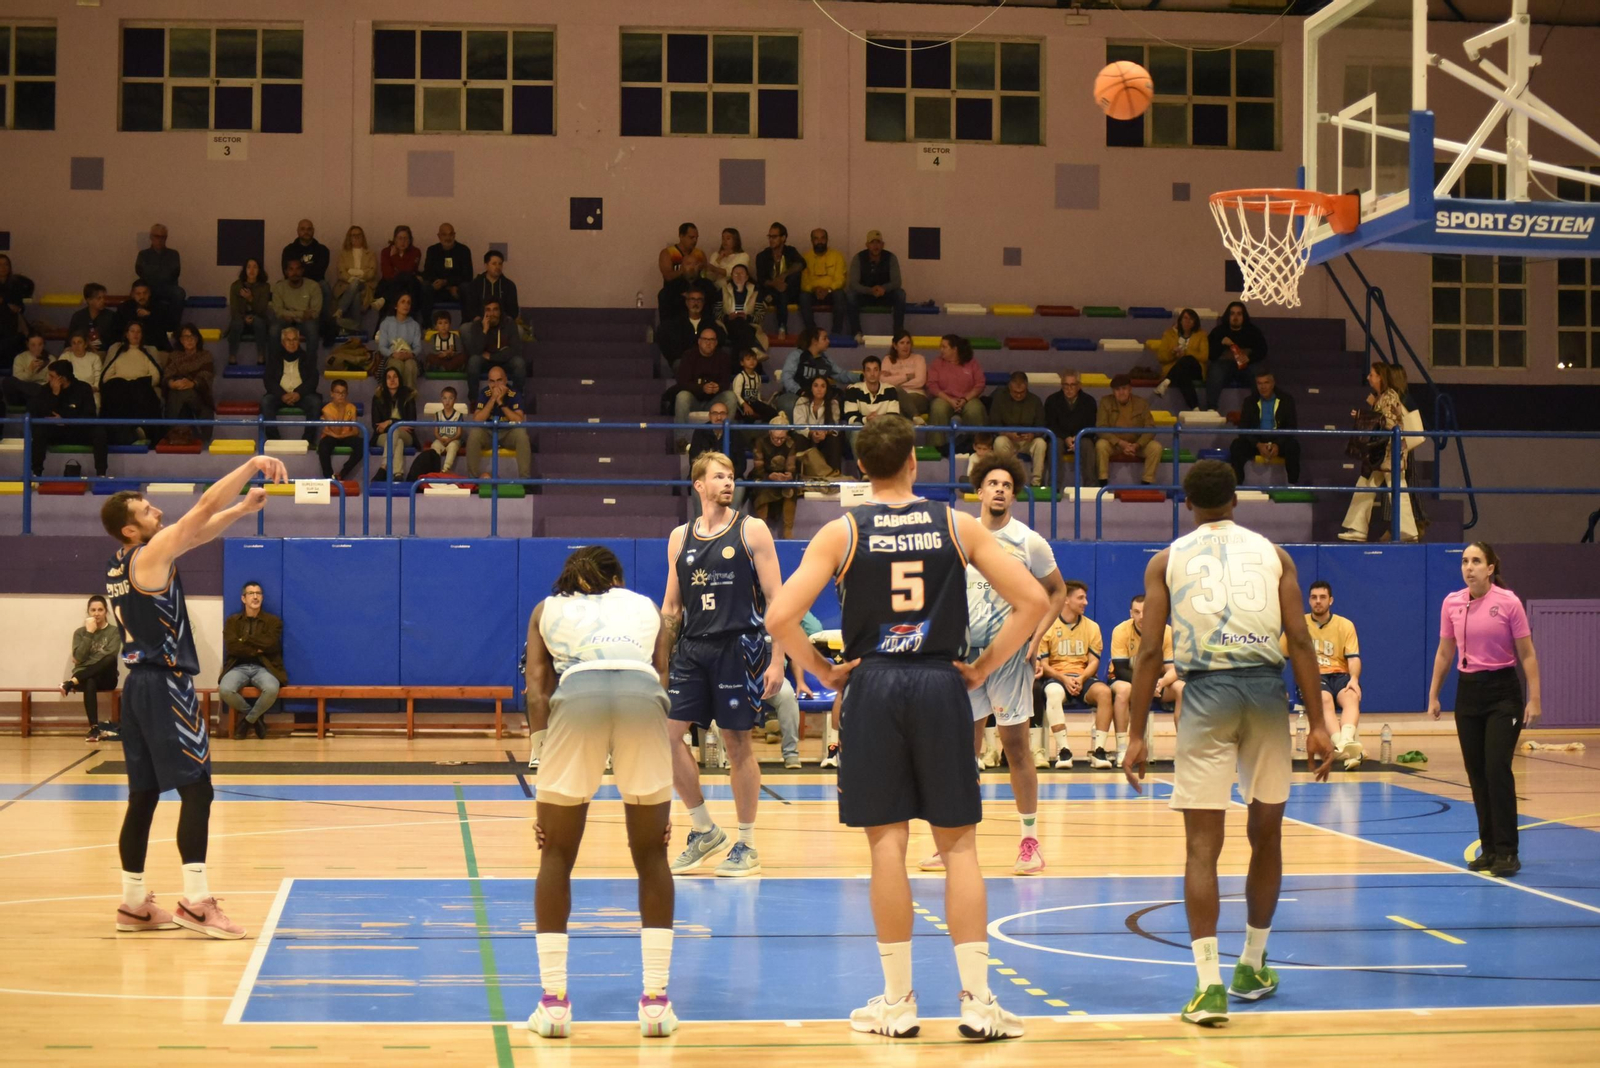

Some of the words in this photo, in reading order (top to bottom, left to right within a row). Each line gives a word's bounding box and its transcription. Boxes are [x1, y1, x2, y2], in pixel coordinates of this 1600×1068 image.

[223, 145, 231, 156] 3
[932, 156, 940, 167] 4
[873, 511, 933, 528] CABRERA
[897, 531, 943, 552] STROG
[890, 560, 925, 613] 5
[1185, 552, 1268, 615] 35
[700, 593, 716, 611] 15
[1057, 639, 1086, 656] ULB
[1221, 632, 1270, 646] FitoSur
